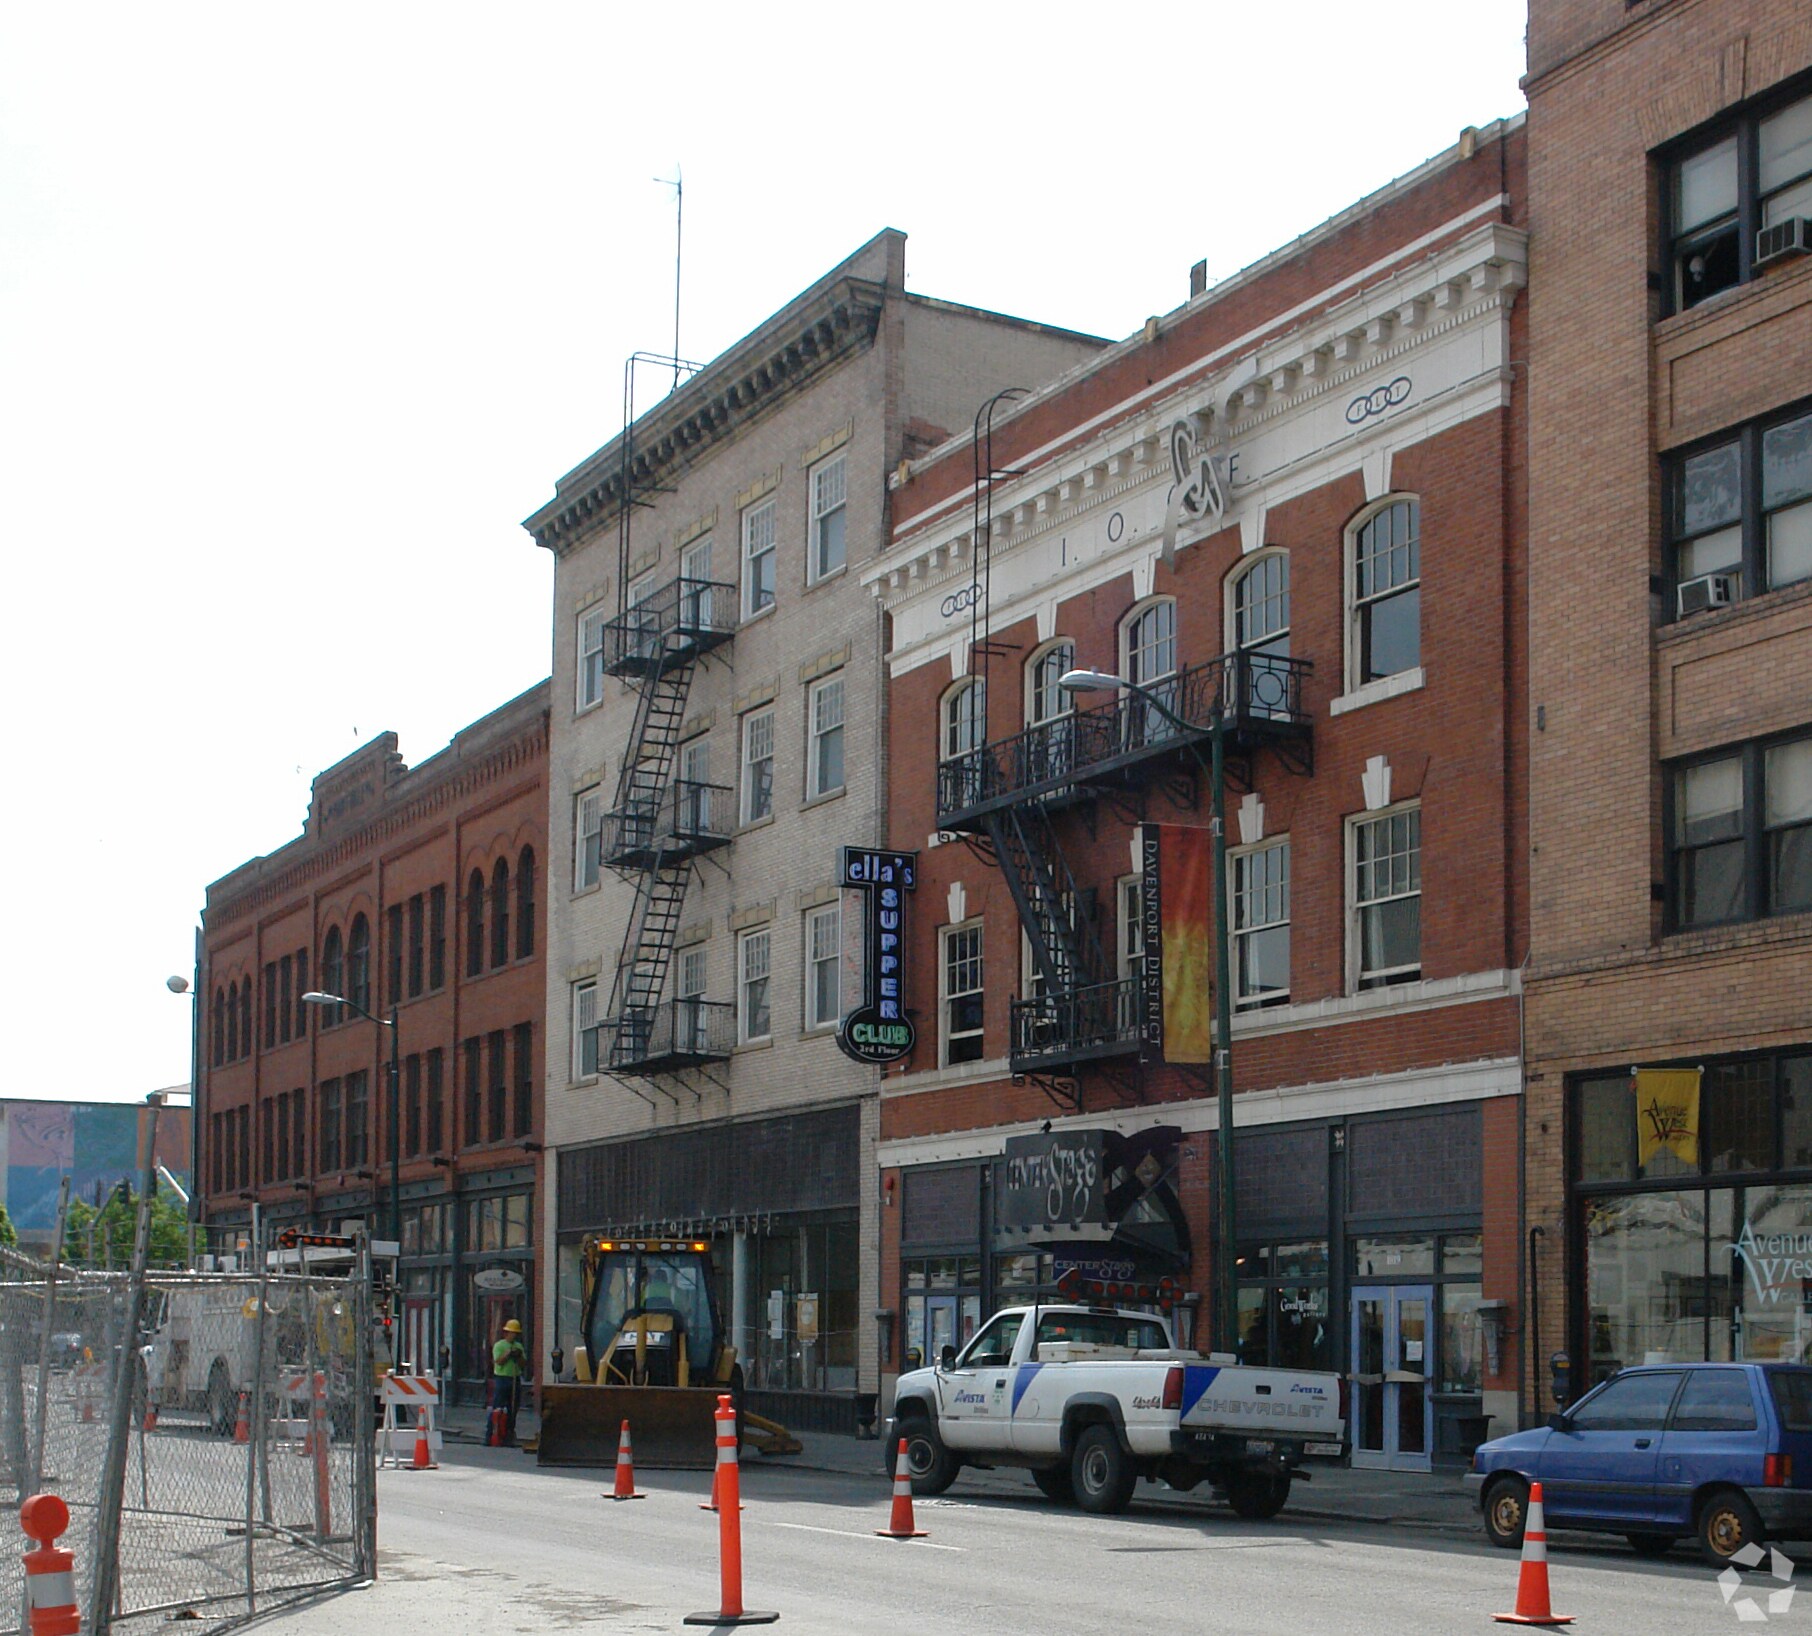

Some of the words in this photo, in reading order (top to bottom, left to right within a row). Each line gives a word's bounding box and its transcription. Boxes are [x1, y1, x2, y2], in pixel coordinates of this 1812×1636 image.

[849, 854, 914, 885] ella's
[1145, 840, 1159, 947] DAVENPORT
[879, 887, 899, 1019] SUPPER
[1148, 956, 1161, 1048] DISTRICT
[851, 1022, 909, 1045] CLUB
[1197, 1398, 1325, 1418] CHEVROLET
